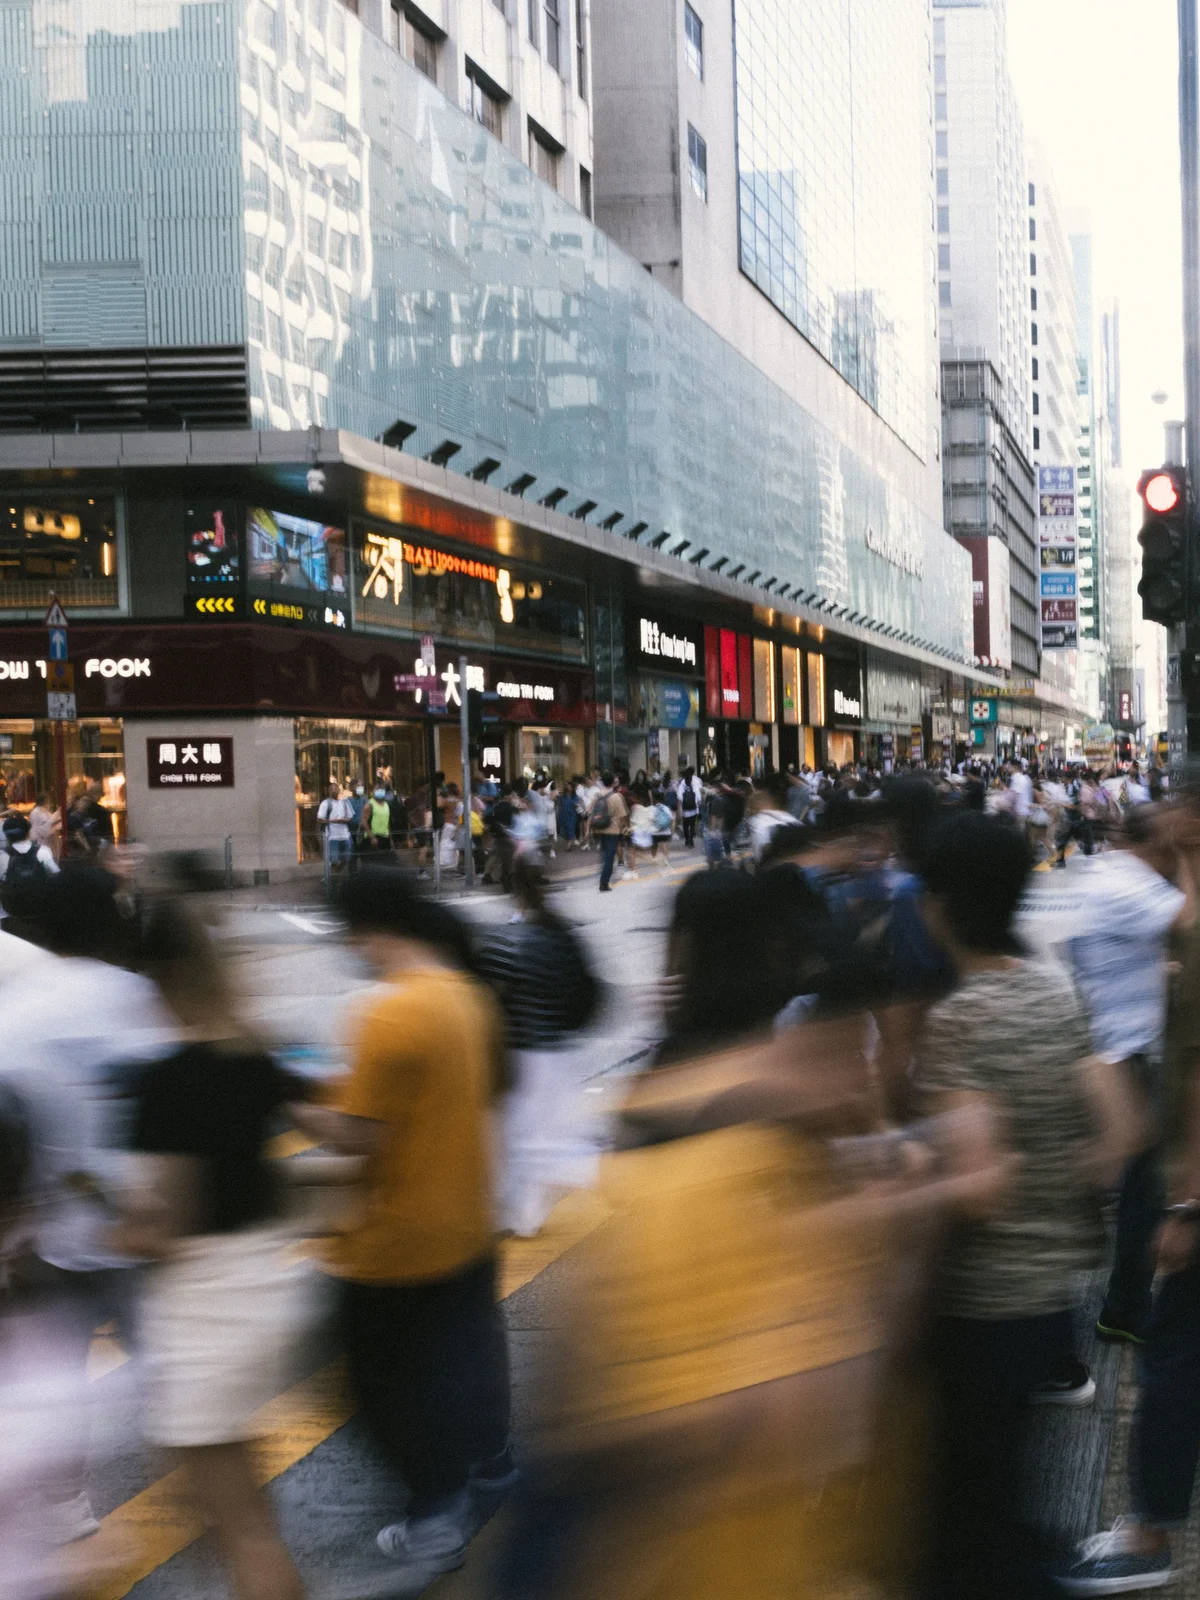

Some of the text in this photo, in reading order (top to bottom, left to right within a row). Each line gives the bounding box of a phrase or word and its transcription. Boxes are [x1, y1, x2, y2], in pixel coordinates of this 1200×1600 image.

[85, 657, 152, 678] FOOK
[160, 773, 183, 783] CHOW
[184, 773, 198, 782] TAI
